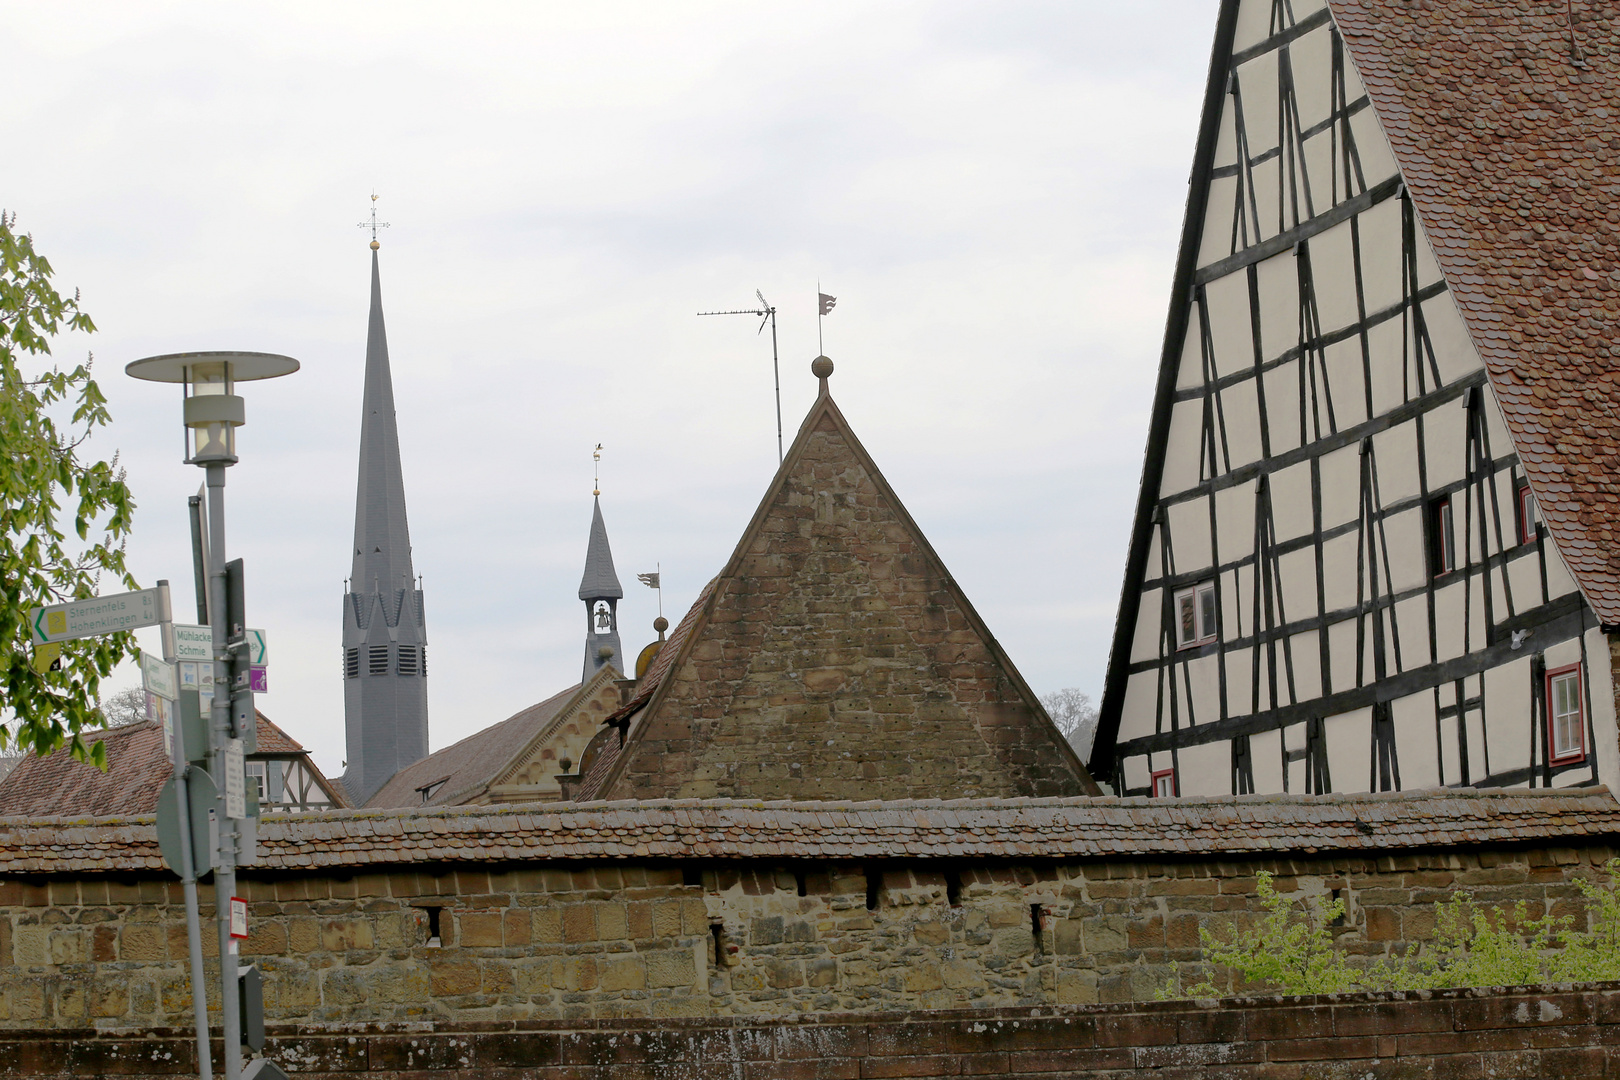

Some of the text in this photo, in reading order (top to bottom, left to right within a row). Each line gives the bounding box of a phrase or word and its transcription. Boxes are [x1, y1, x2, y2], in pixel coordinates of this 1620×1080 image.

[70, 600, 126, 618] Sternenfels
[70, 613, 137, 632] Hohenklingen
[177, 631, 212, 642] Mühlacke
[178, 645, 206, 656] Schmie
